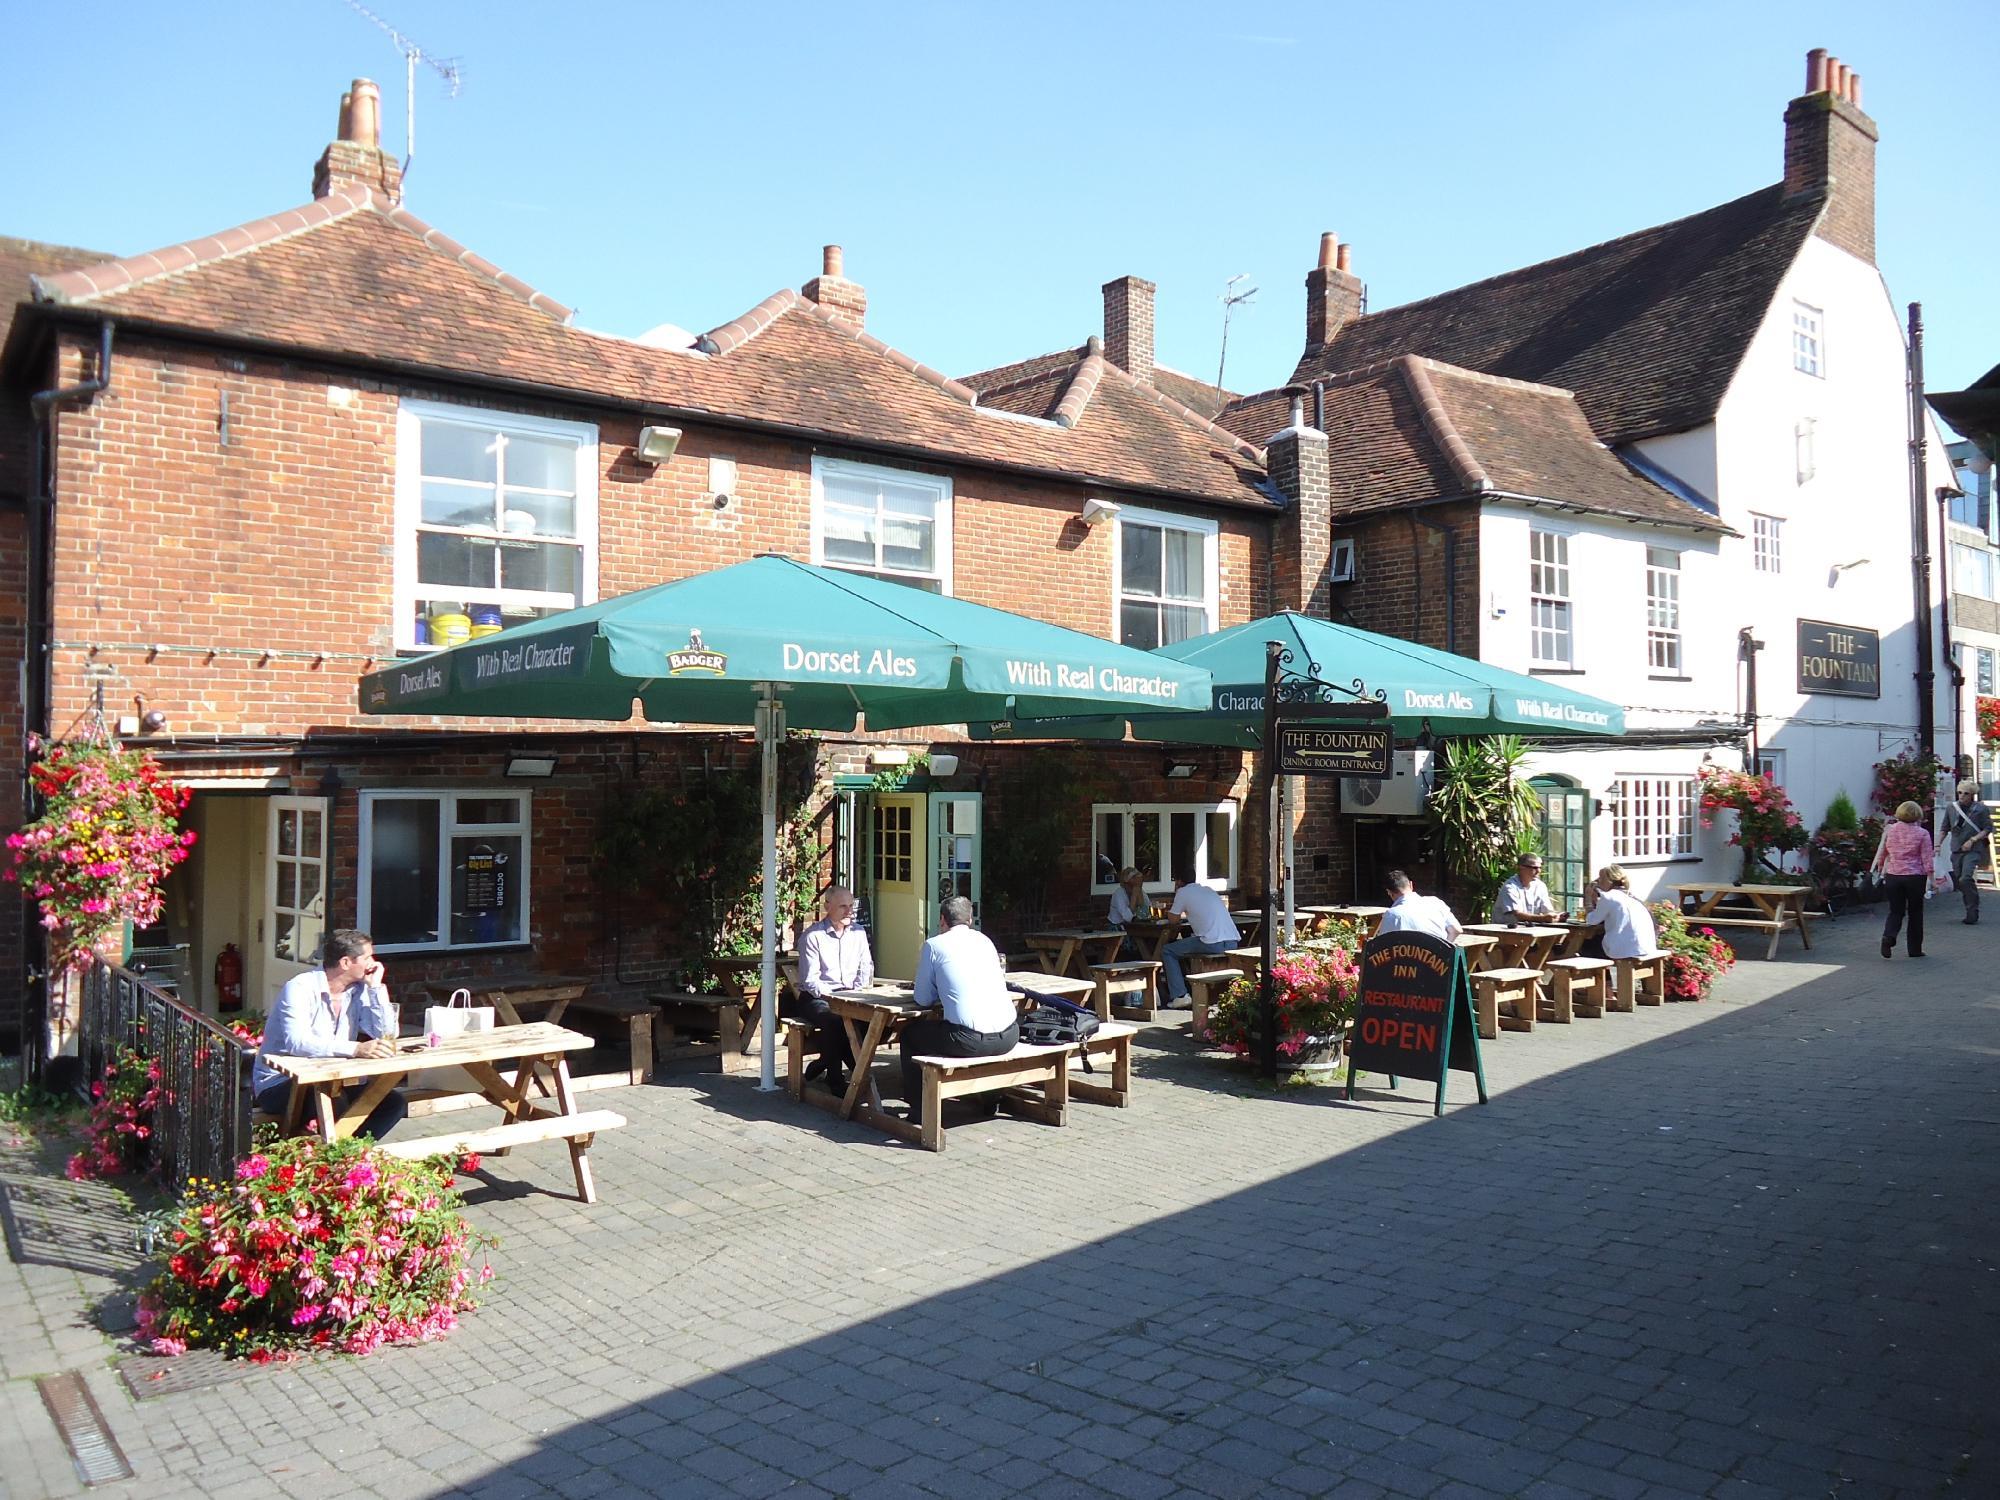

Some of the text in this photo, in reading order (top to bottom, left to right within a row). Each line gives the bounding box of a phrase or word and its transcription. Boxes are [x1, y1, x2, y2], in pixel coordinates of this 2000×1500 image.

[1827, 632, 1855, 655] THE
[476, 642, 574, 679] With Real Character
[670, 654, 723, 670] BADGER
[783, 643, 917, 677] Dorset Ales
[1802, 655, 1877, 682] FOUNTAIN
[400, 665, 442, 694] Dorset Ales
[1006, 660, 1179, 698] With Real Character
[1218, 692, 1265, 710] Charac
[1405, 689, 1473, 710] Dorset Ales
[1516, 699, 1541, 717] With
[1542, 701, 1564, 720] Real
[1285, 733, 1384, 749] THE FOUNTAIN
[1283, 757, 1384, 770] DINING ROOM ENTRANCE
[1368, 944, 1449, 976] THE FOUNTAIN
[1393, 964, 1417, 978] INN
[1364, 990, 1445, 1012] RESTAURANT
[1362, 1017, 1437, 1053] OPEN
